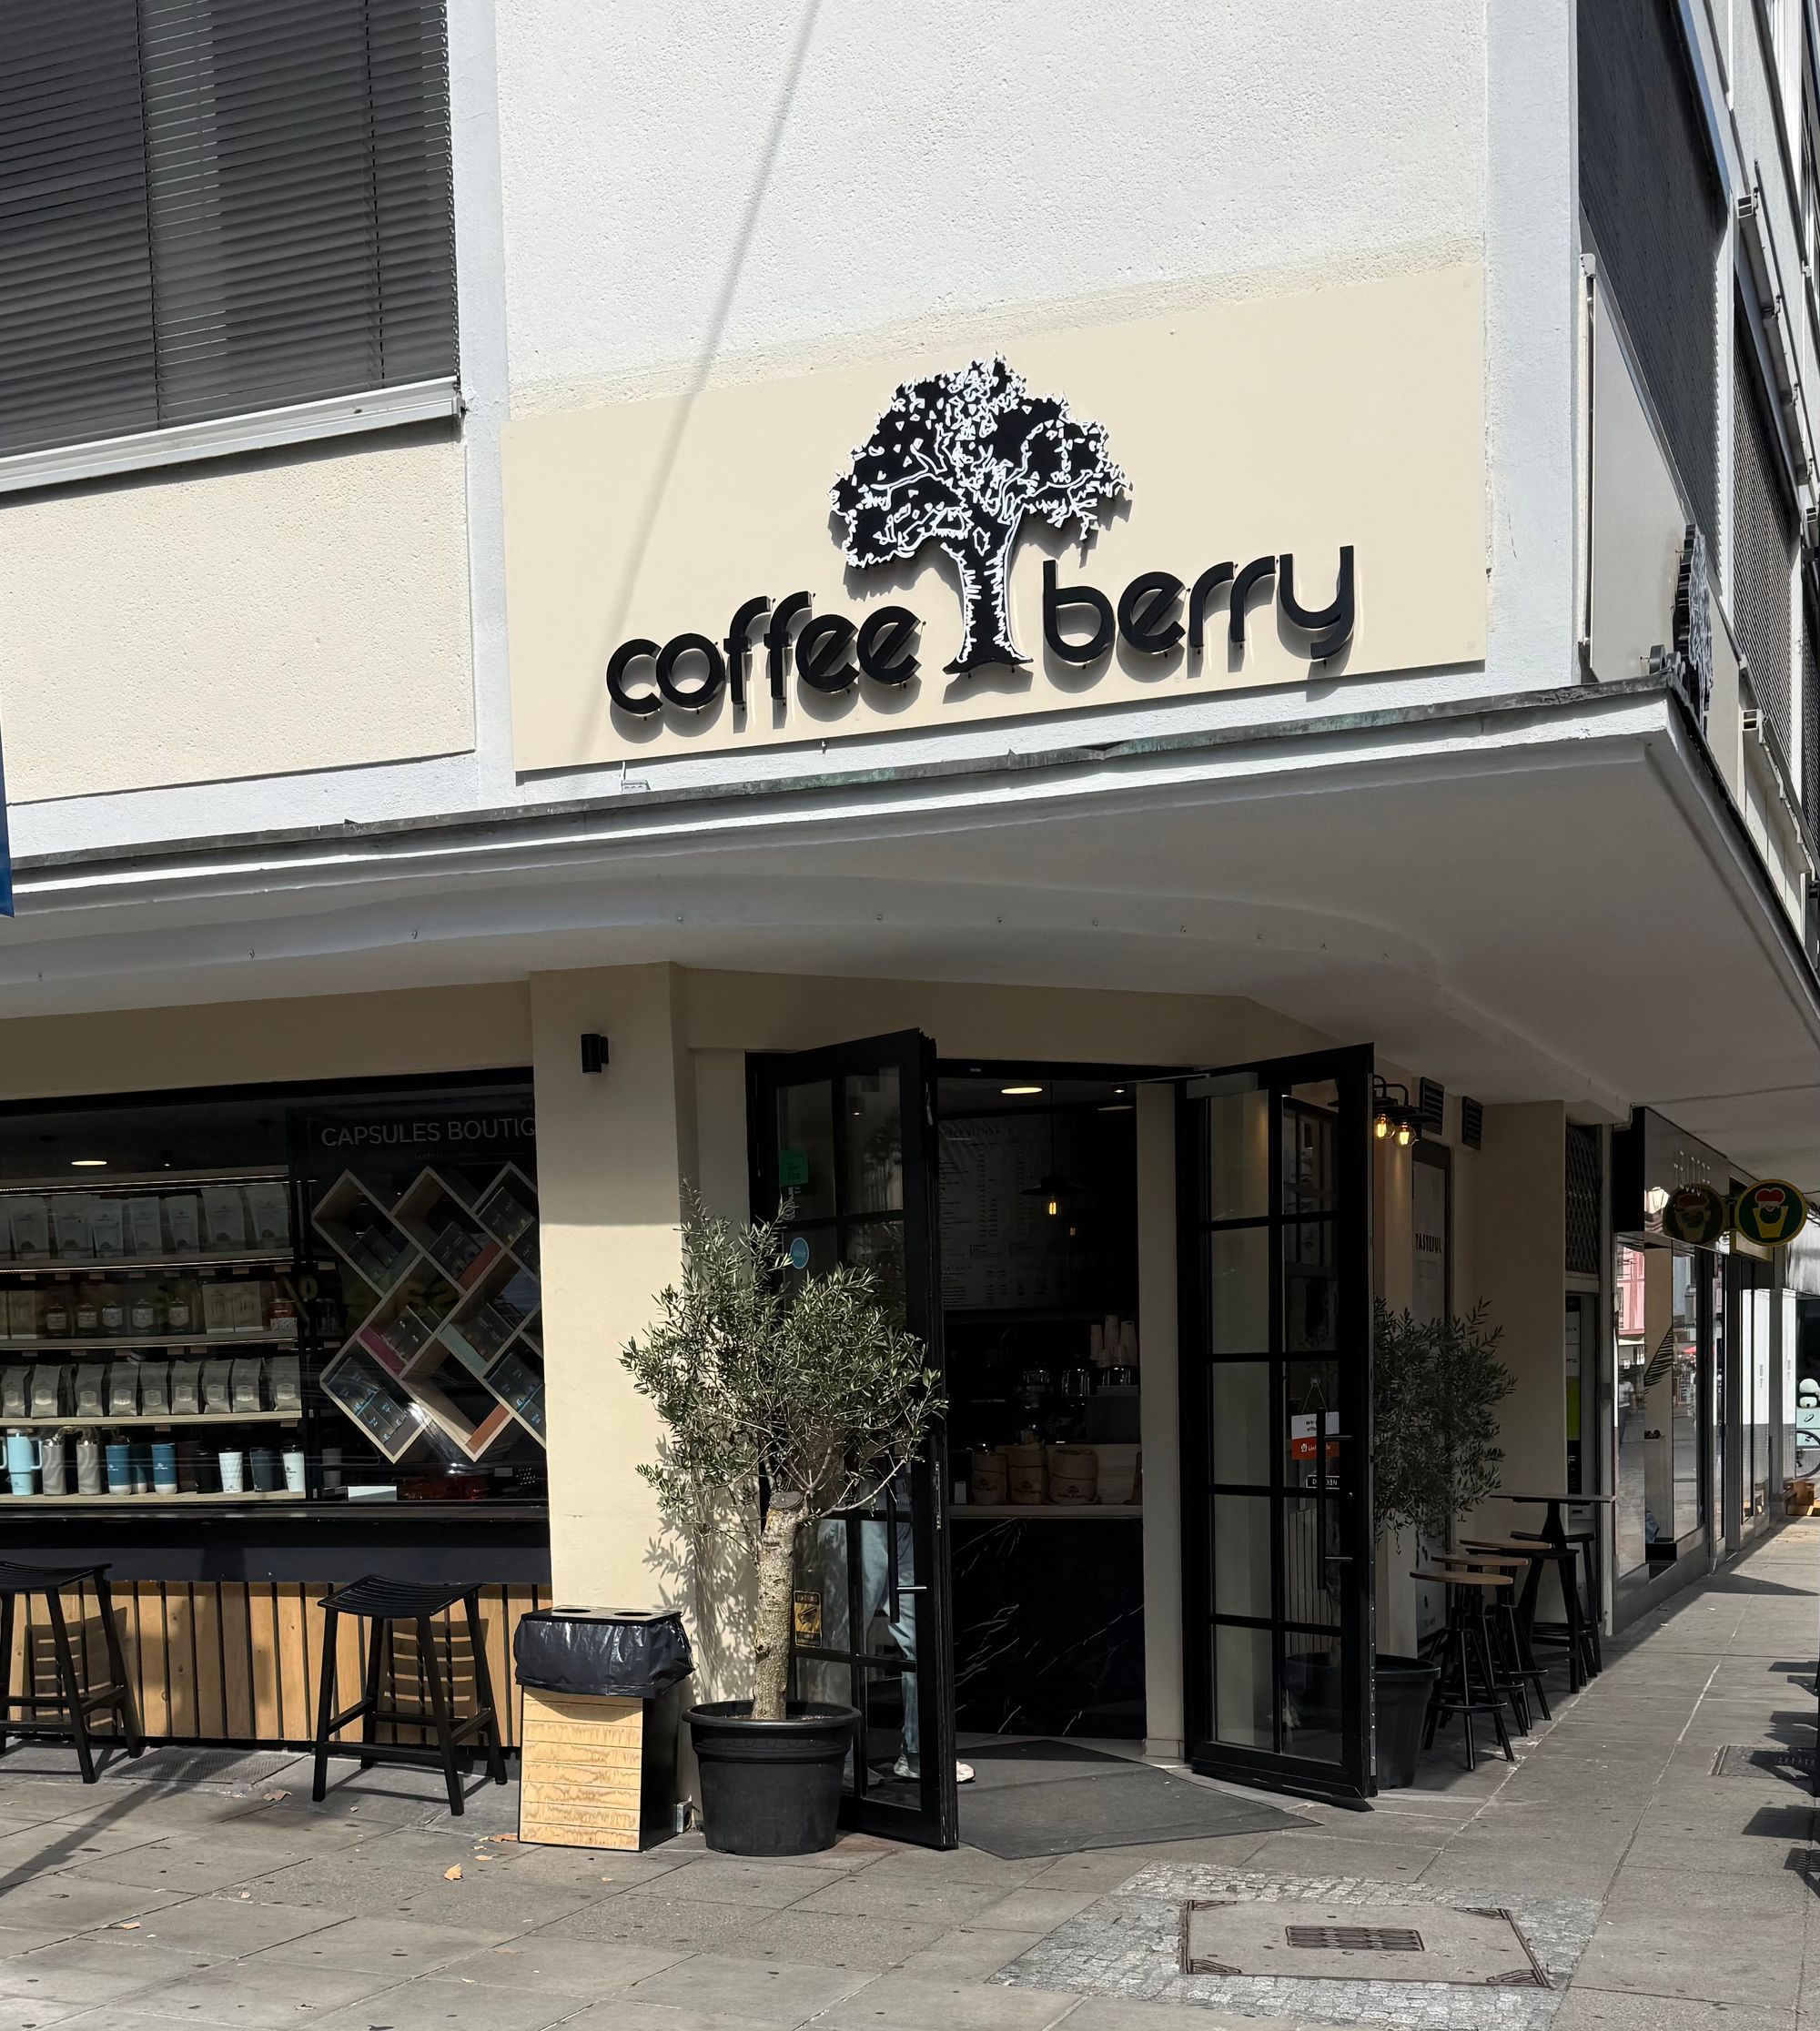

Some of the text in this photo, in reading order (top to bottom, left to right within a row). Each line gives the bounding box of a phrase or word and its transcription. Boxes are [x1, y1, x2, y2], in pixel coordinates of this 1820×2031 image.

[607, 546, 1354, 713] coffee berry
[320, 1122, 440, 1147] CAPSULES
